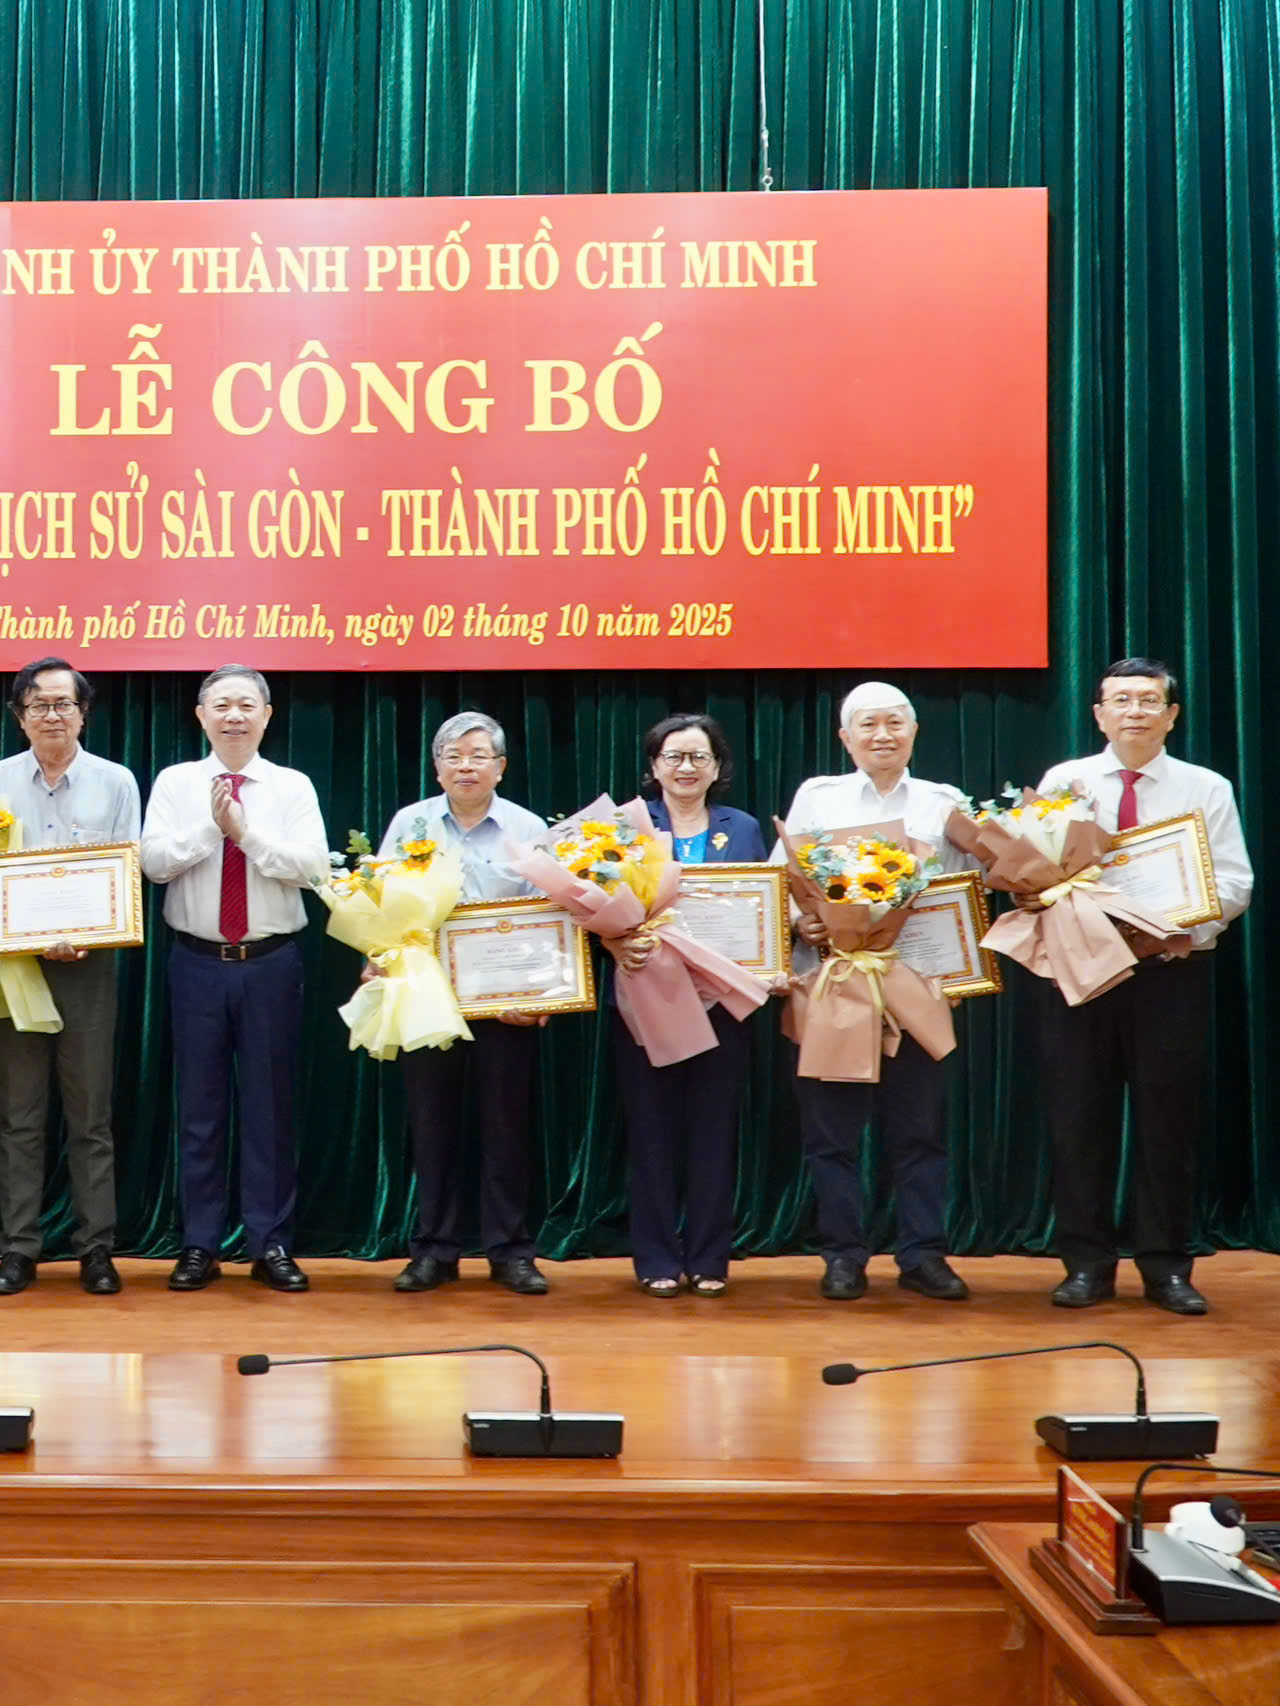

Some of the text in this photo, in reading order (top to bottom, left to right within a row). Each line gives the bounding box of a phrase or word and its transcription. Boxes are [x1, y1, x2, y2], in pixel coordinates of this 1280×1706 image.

[89, 228, 159, 295] ỦY
[173, 232, 350, 293] THÀNH
[364, 220, 471, 291] PHỐ
[485, 216, 559, 290] HỒ
[576, 226, 666, 289] CHÍ
[680, 240, 817, 288] MINH
[50, 322, 663, 436] LỄ CÔNG BỐ
[90, 461, 149, 560] SỬ
[162, 469, 235, 560] SÀI
[248, 468, 344, 559] GÒN
[357, 527, 369, 541] -
[382, 467, 540, 557] THÀNH
[552, 453, 648, 557] PHỐ
[660, 448, 726, 556] HỒ
[741, 464, 822, 555] CHÍ
[833, 484, 975, 555] MINH”
[80, 601, 140, 648] phố
[144, 599, 186, 639] Hồ
[195, 605, 247, 638] Chí
[253, 604, 335, 645] Minh,
[345, 605, 414, 647] ngày
[423, 604, 454, 637] 02
[463, 603, 549, 646] tháng
[557, 603, 590, 637] 10
[597, 604, 660, 637] năm
[667, 602, 734, 637] 2025
